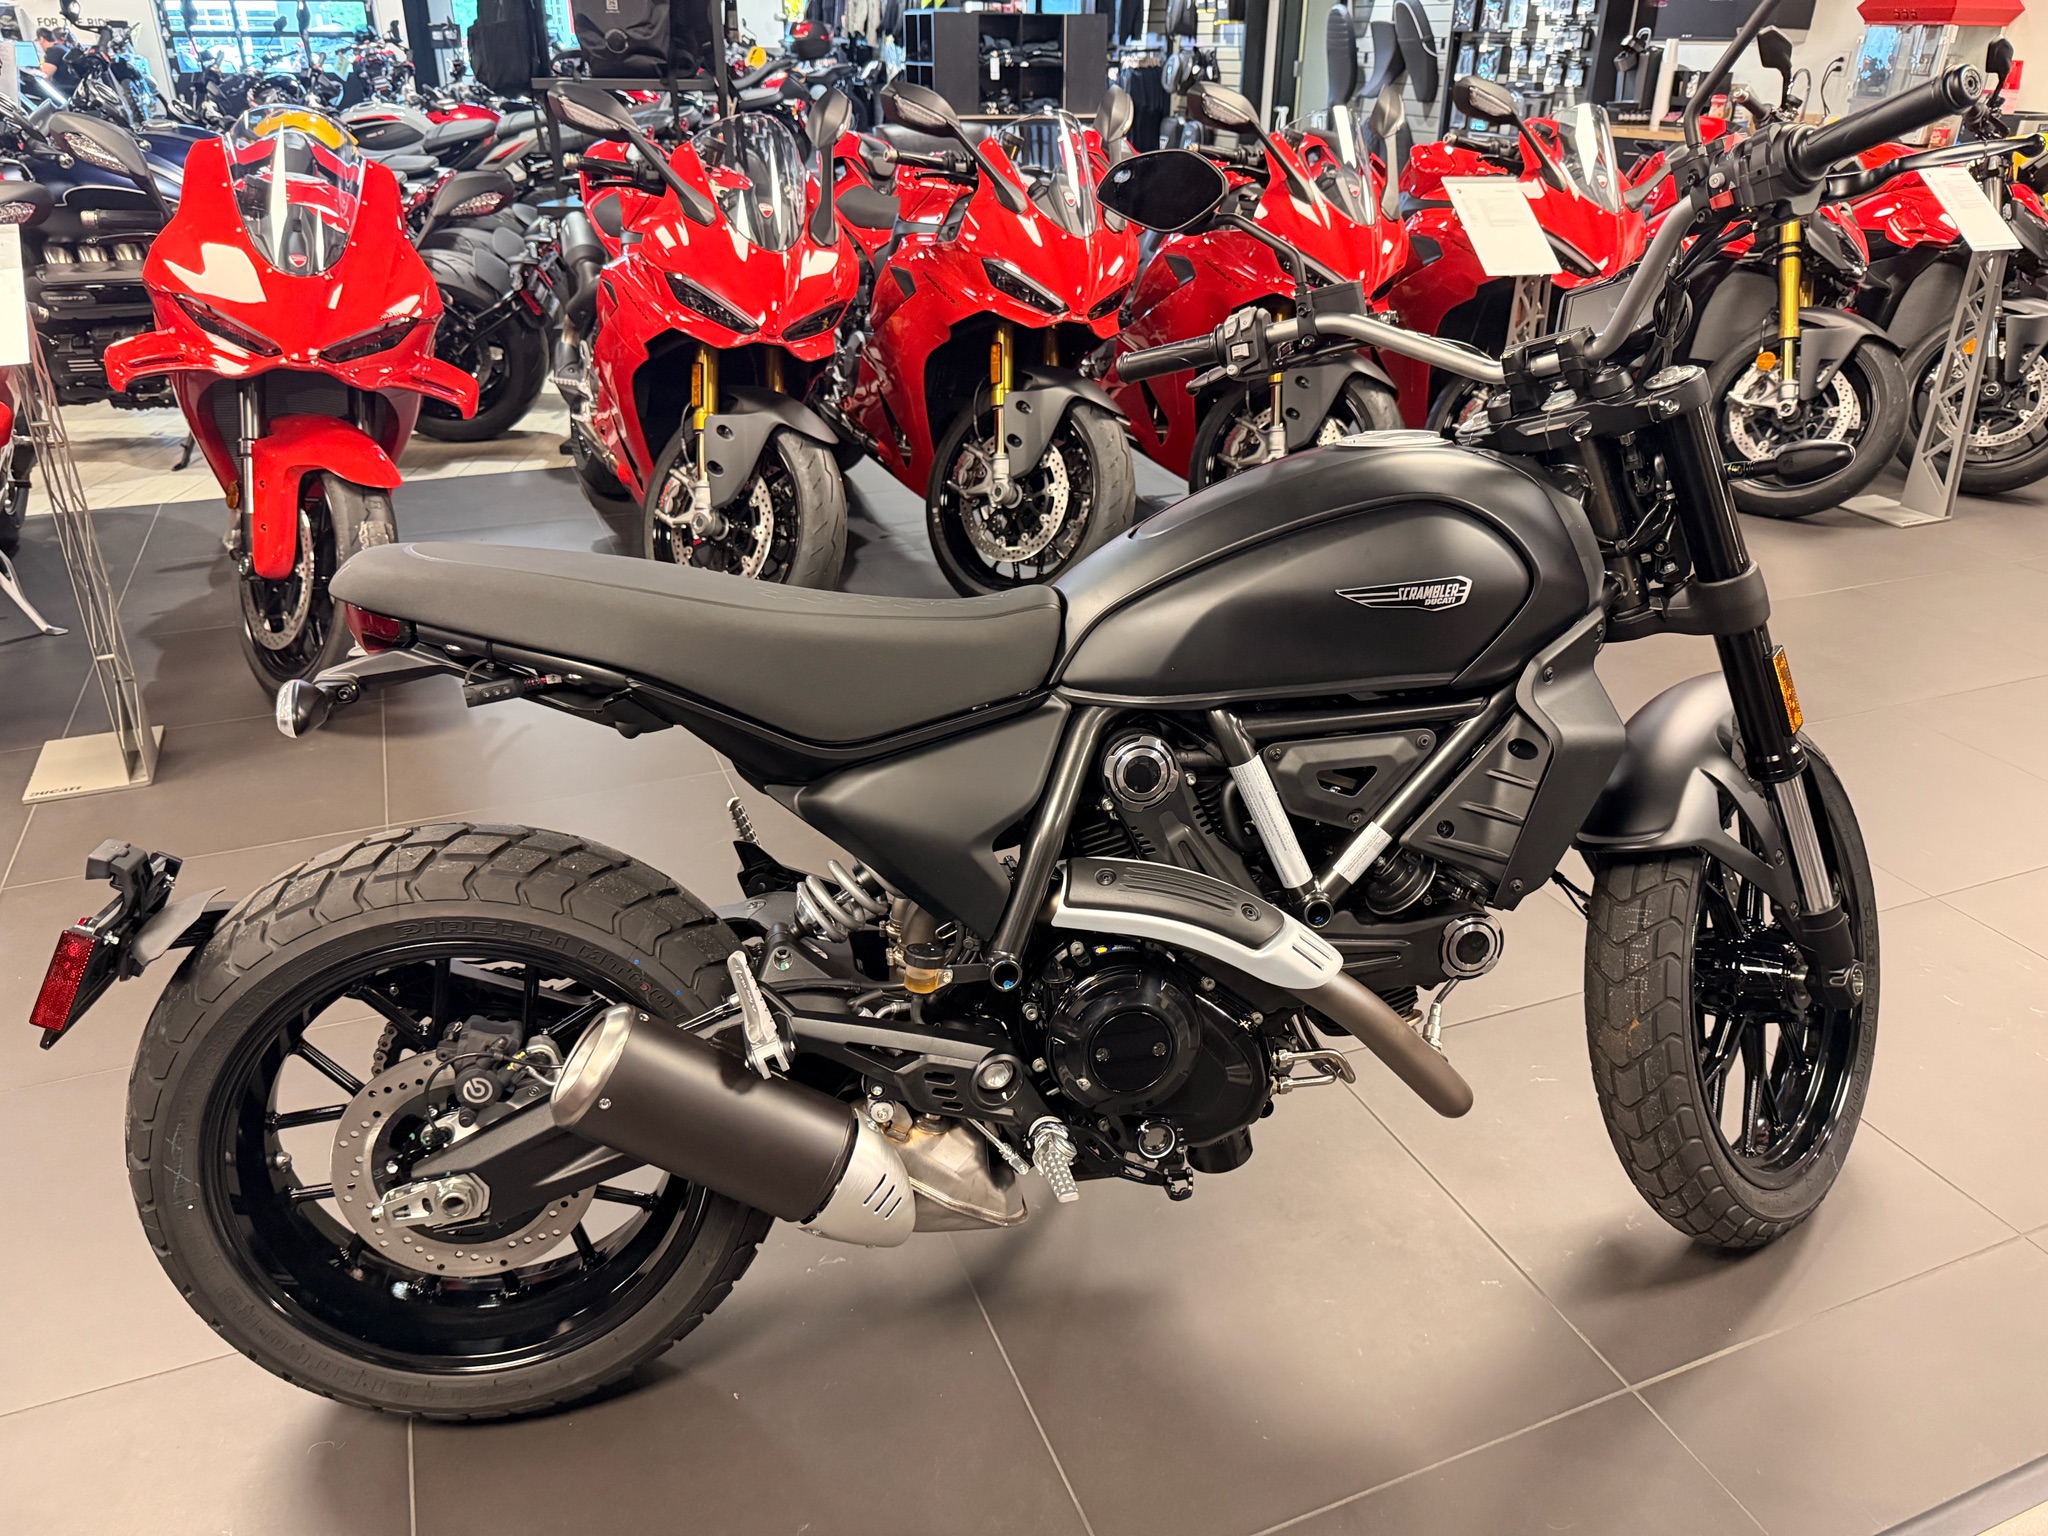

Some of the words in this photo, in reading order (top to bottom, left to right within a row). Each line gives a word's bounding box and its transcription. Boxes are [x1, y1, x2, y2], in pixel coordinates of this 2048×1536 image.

[37, 17, 59, 27] FOR
[1397, 583, 1460, 601] SCRAMBLER
[1424, 596, 1456, 606] DUCATI
[29, 786, 82, 797] DUCATI
[394, 920, 568, 950] PIRELLI
